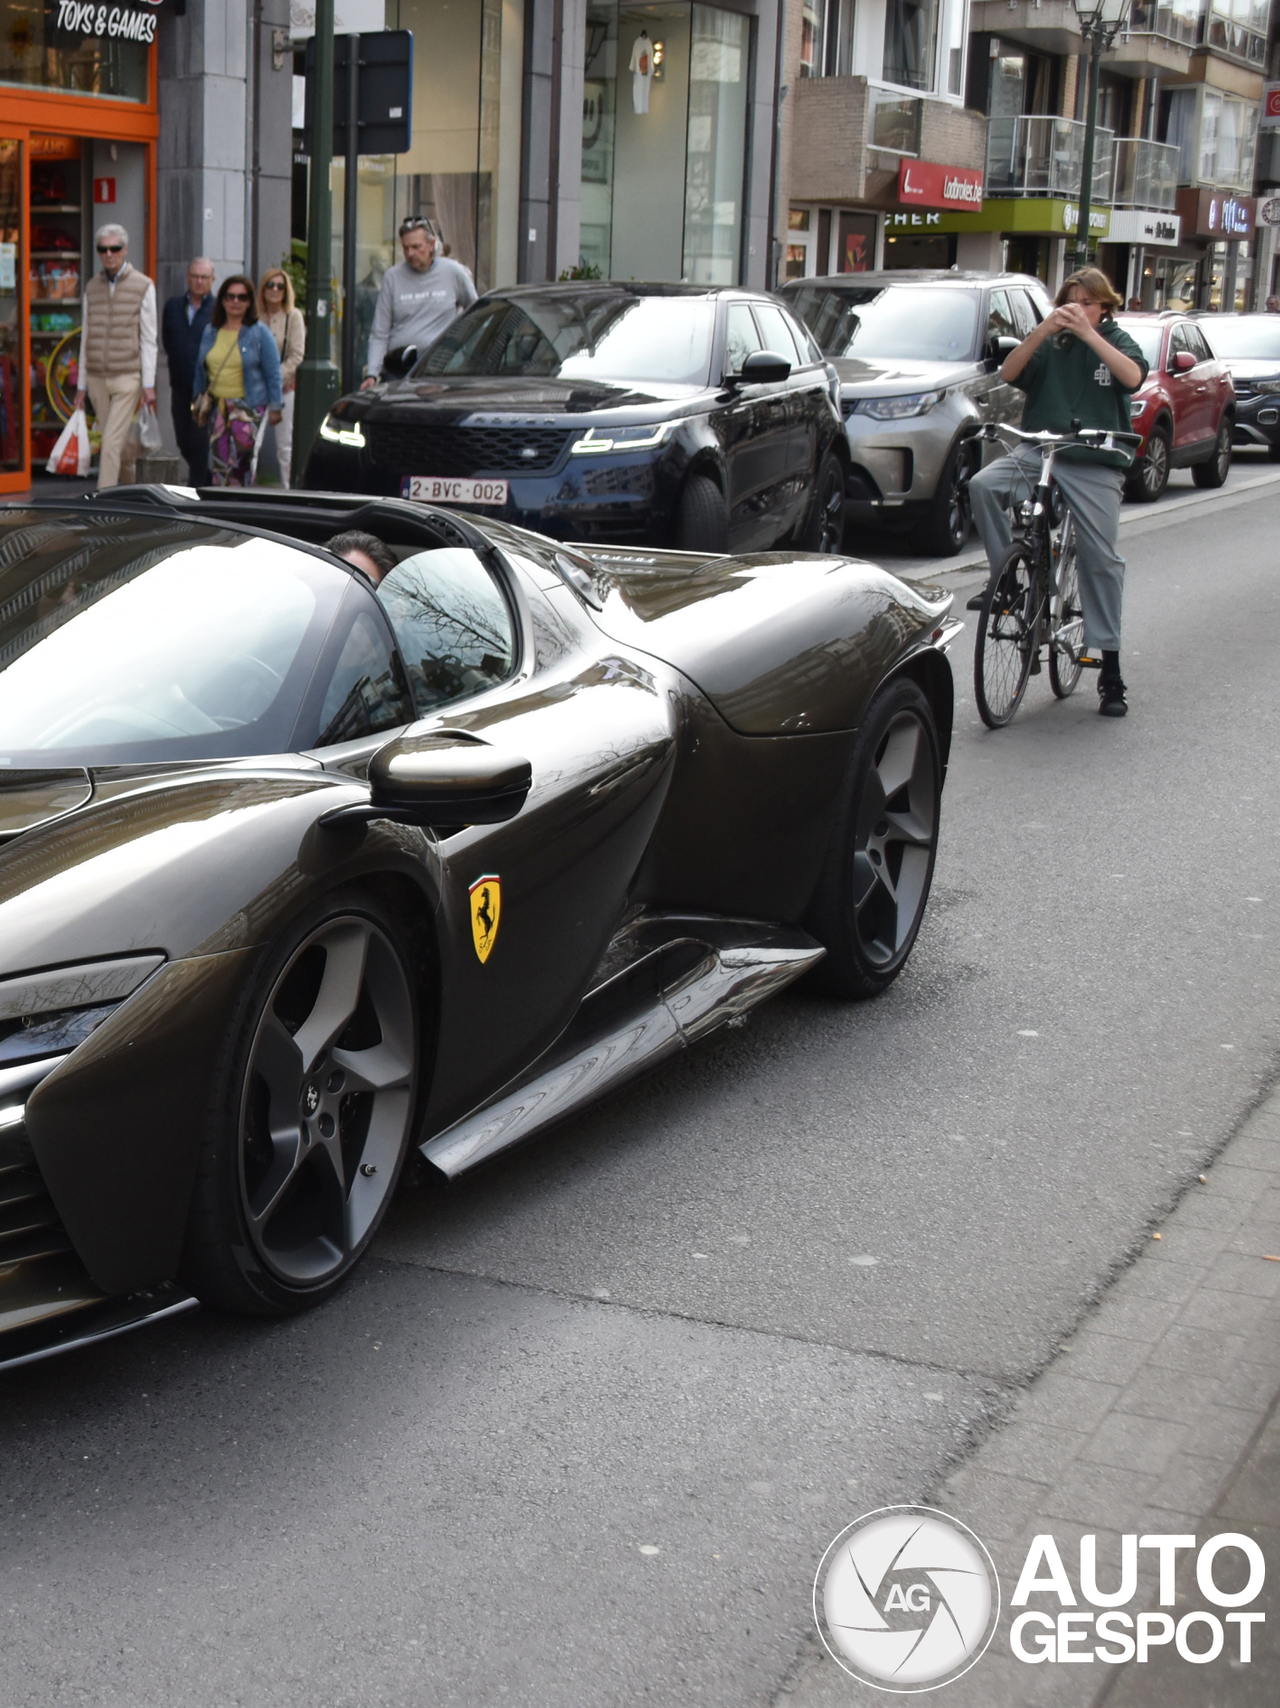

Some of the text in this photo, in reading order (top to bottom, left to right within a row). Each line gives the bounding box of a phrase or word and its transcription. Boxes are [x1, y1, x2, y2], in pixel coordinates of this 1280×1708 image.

[57, 0, 157, 43] TOYS & GAMES
[943, 175, 982, 202] Ladbrokes.be
[412, 481, 504, 501] 2-BVC-002
